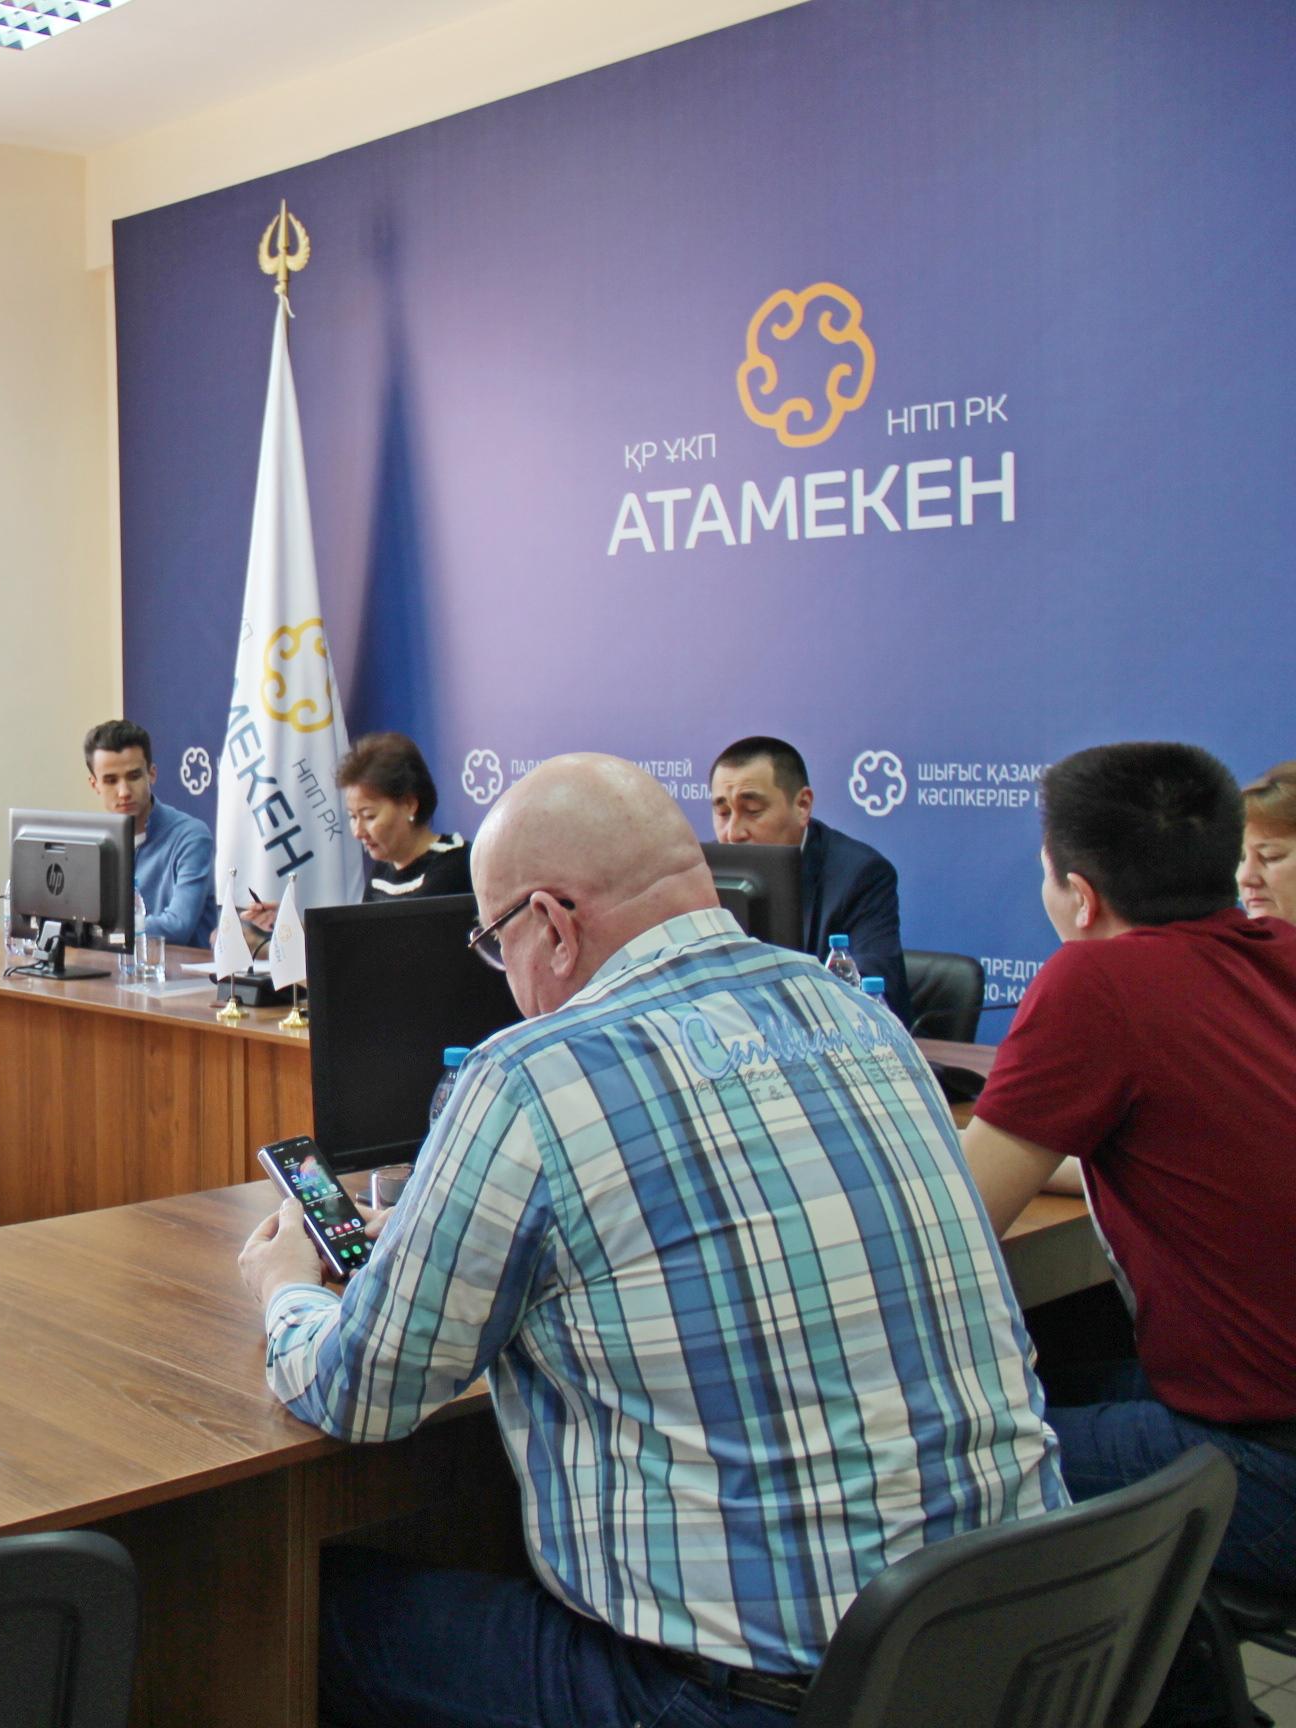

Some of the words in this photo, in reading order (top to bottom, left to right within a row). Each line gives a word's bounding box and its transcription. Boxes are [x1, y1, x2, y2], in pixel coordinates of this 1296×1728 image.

[887, 401, 955, 435] НПП
[965, 394, 1008, 426] РК
[624, 441, 657, 473] ҚР
[607, 451, 1015, 556] АТАМЕКЕН
[917, 763, 982, 782] ШЫҒЫС
[292, 758, 327, 809] НПП
[317, 808, 343, 842] РК
[681, 783, 713, 800] ОБЛ
[917, 788, 1030, 808] КӘСІПКЕРЛЕР
[47, 864, 63, 895] hp
